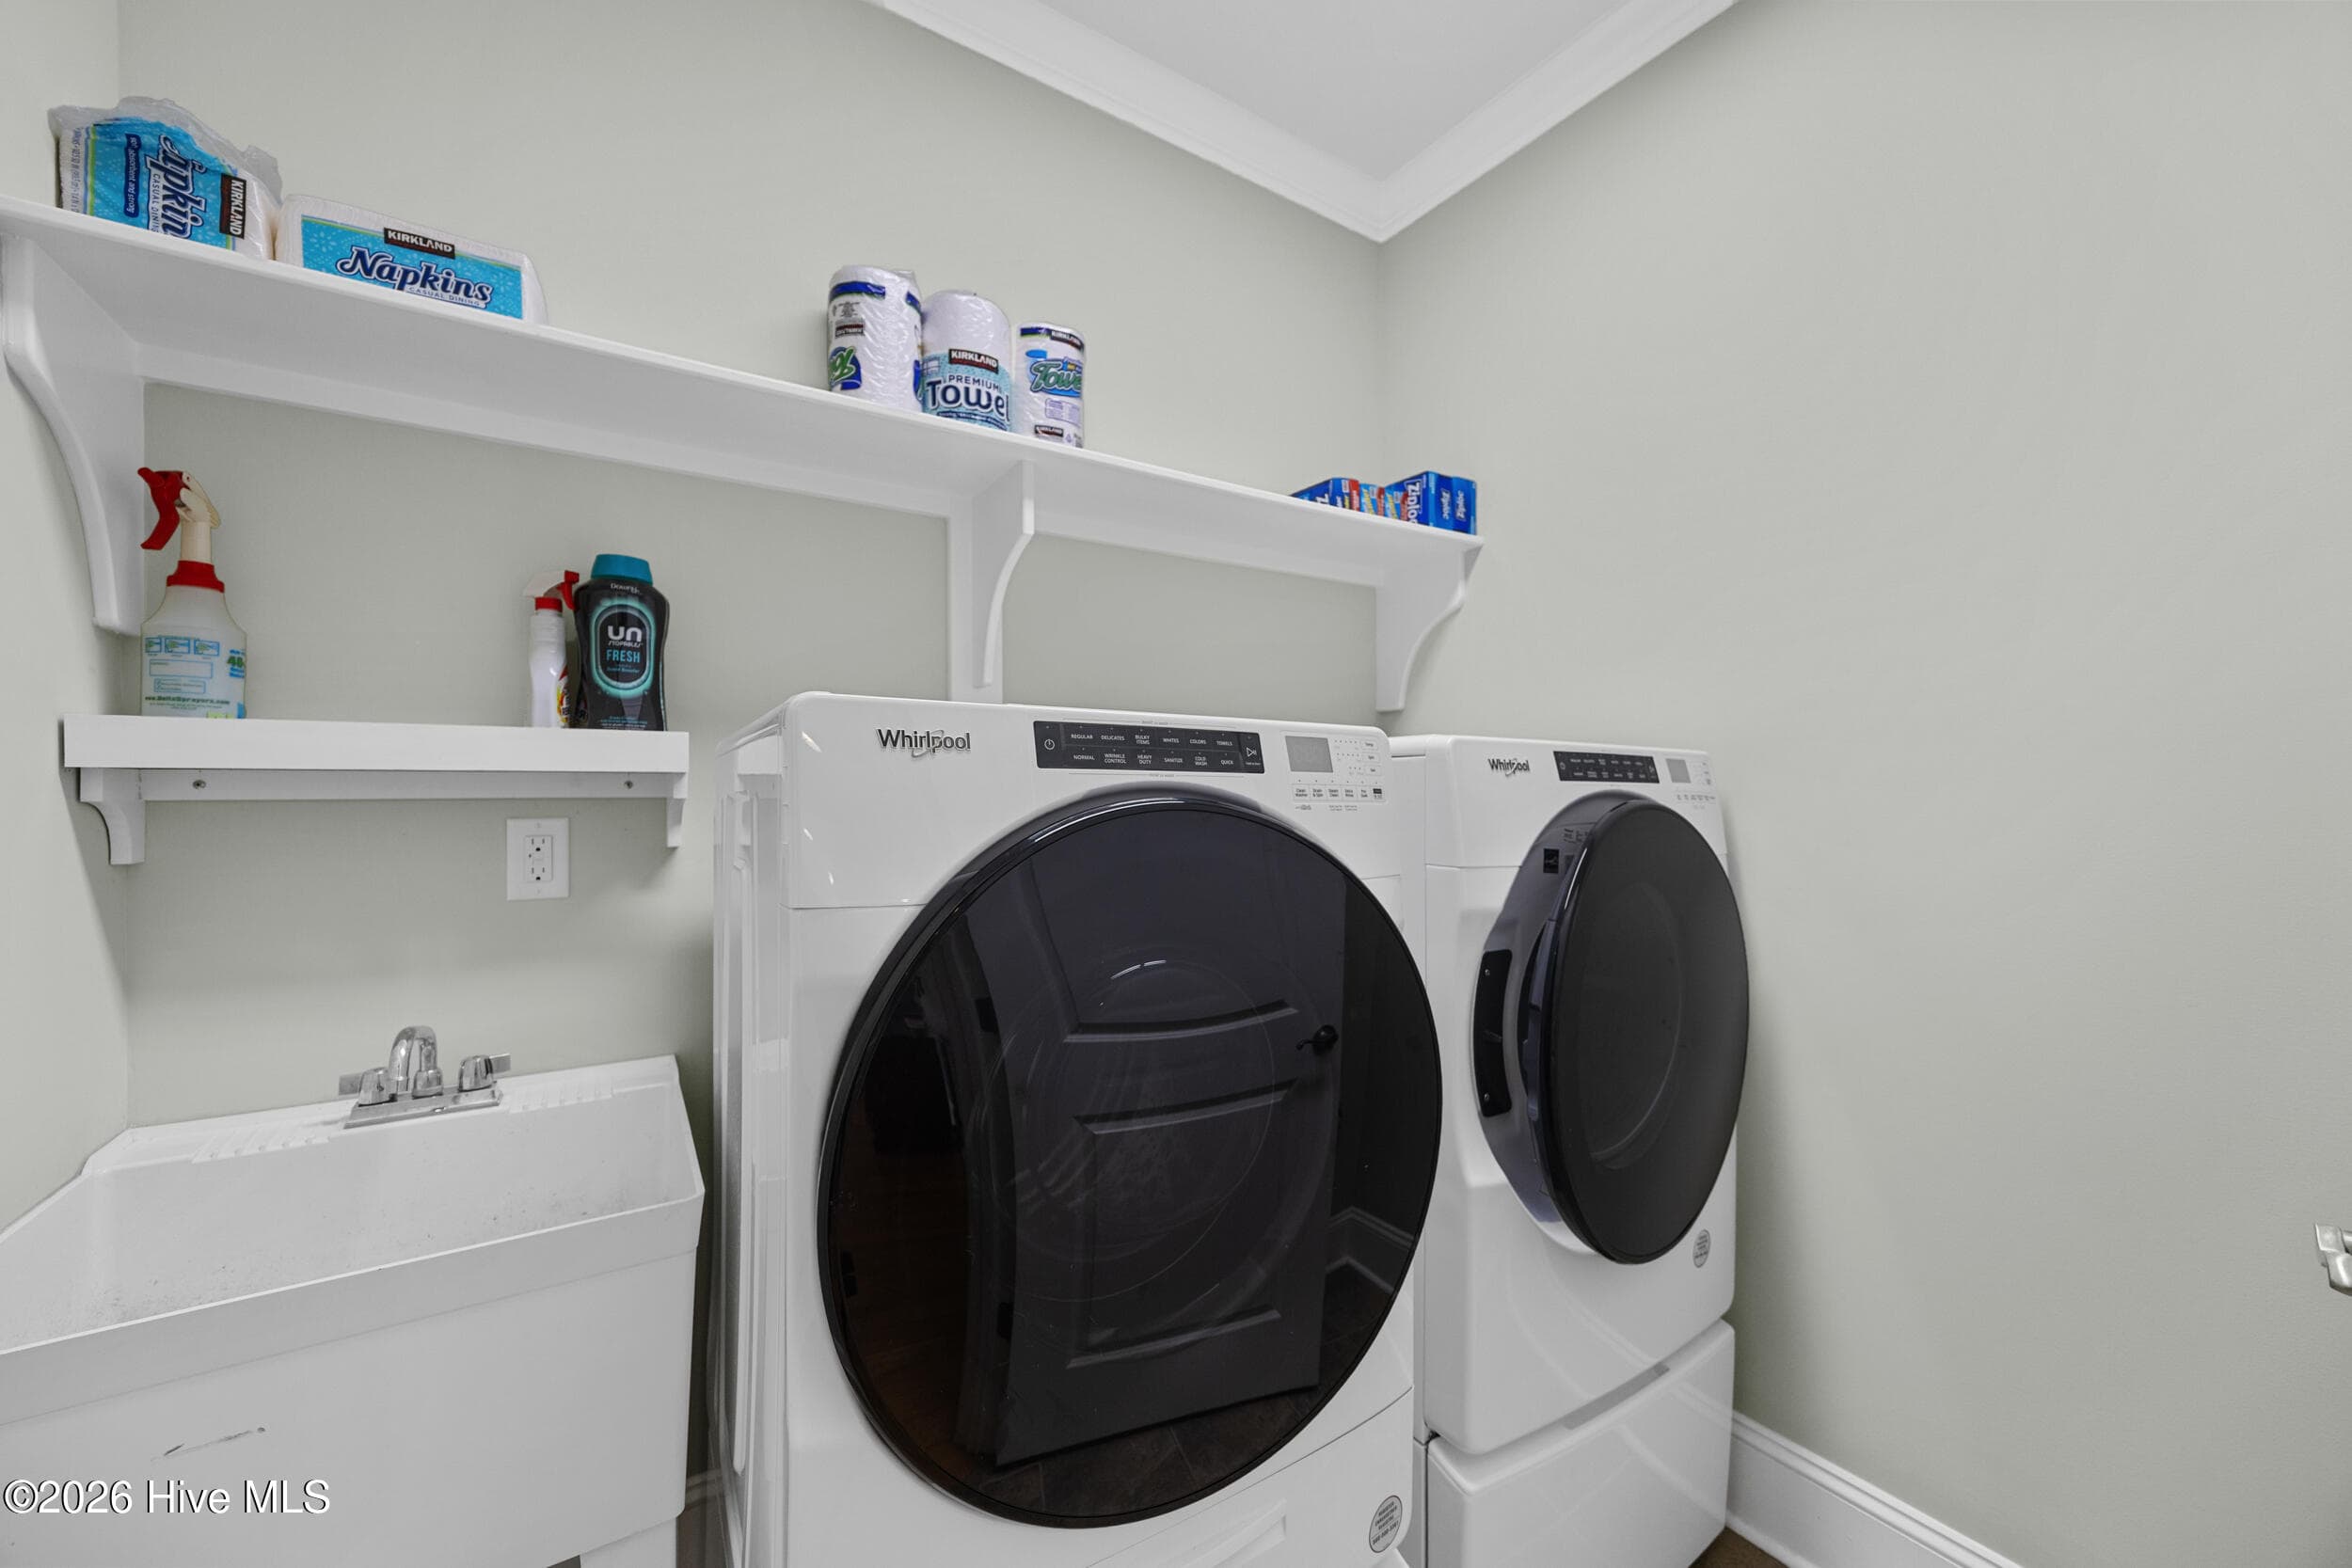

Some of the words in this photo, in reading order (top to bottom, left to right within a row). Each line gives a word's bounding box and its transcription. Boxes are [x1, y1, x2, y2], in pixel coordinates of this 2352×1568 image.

[151, 173, 161, 205] CASUAL
[126, 196, 135, 214] strong
[230, 179, 245, 236] KIRKLAND
[387, 230, 453, 253] KIRKLAND
[337, 246, 493, 302] Napkins
[408, 286, 445, 300] CASUAL
[448, 293, 481, 307] DINING
[950, 351, 997, 368] KIRKLAND
[948, 374, 1000, 391] PREMIUM
[606, 649, 641, 663] FRESH
[877, 728, 971, 753] Whirlpool
[1487, 757, 1530, 774] Whirlpool
